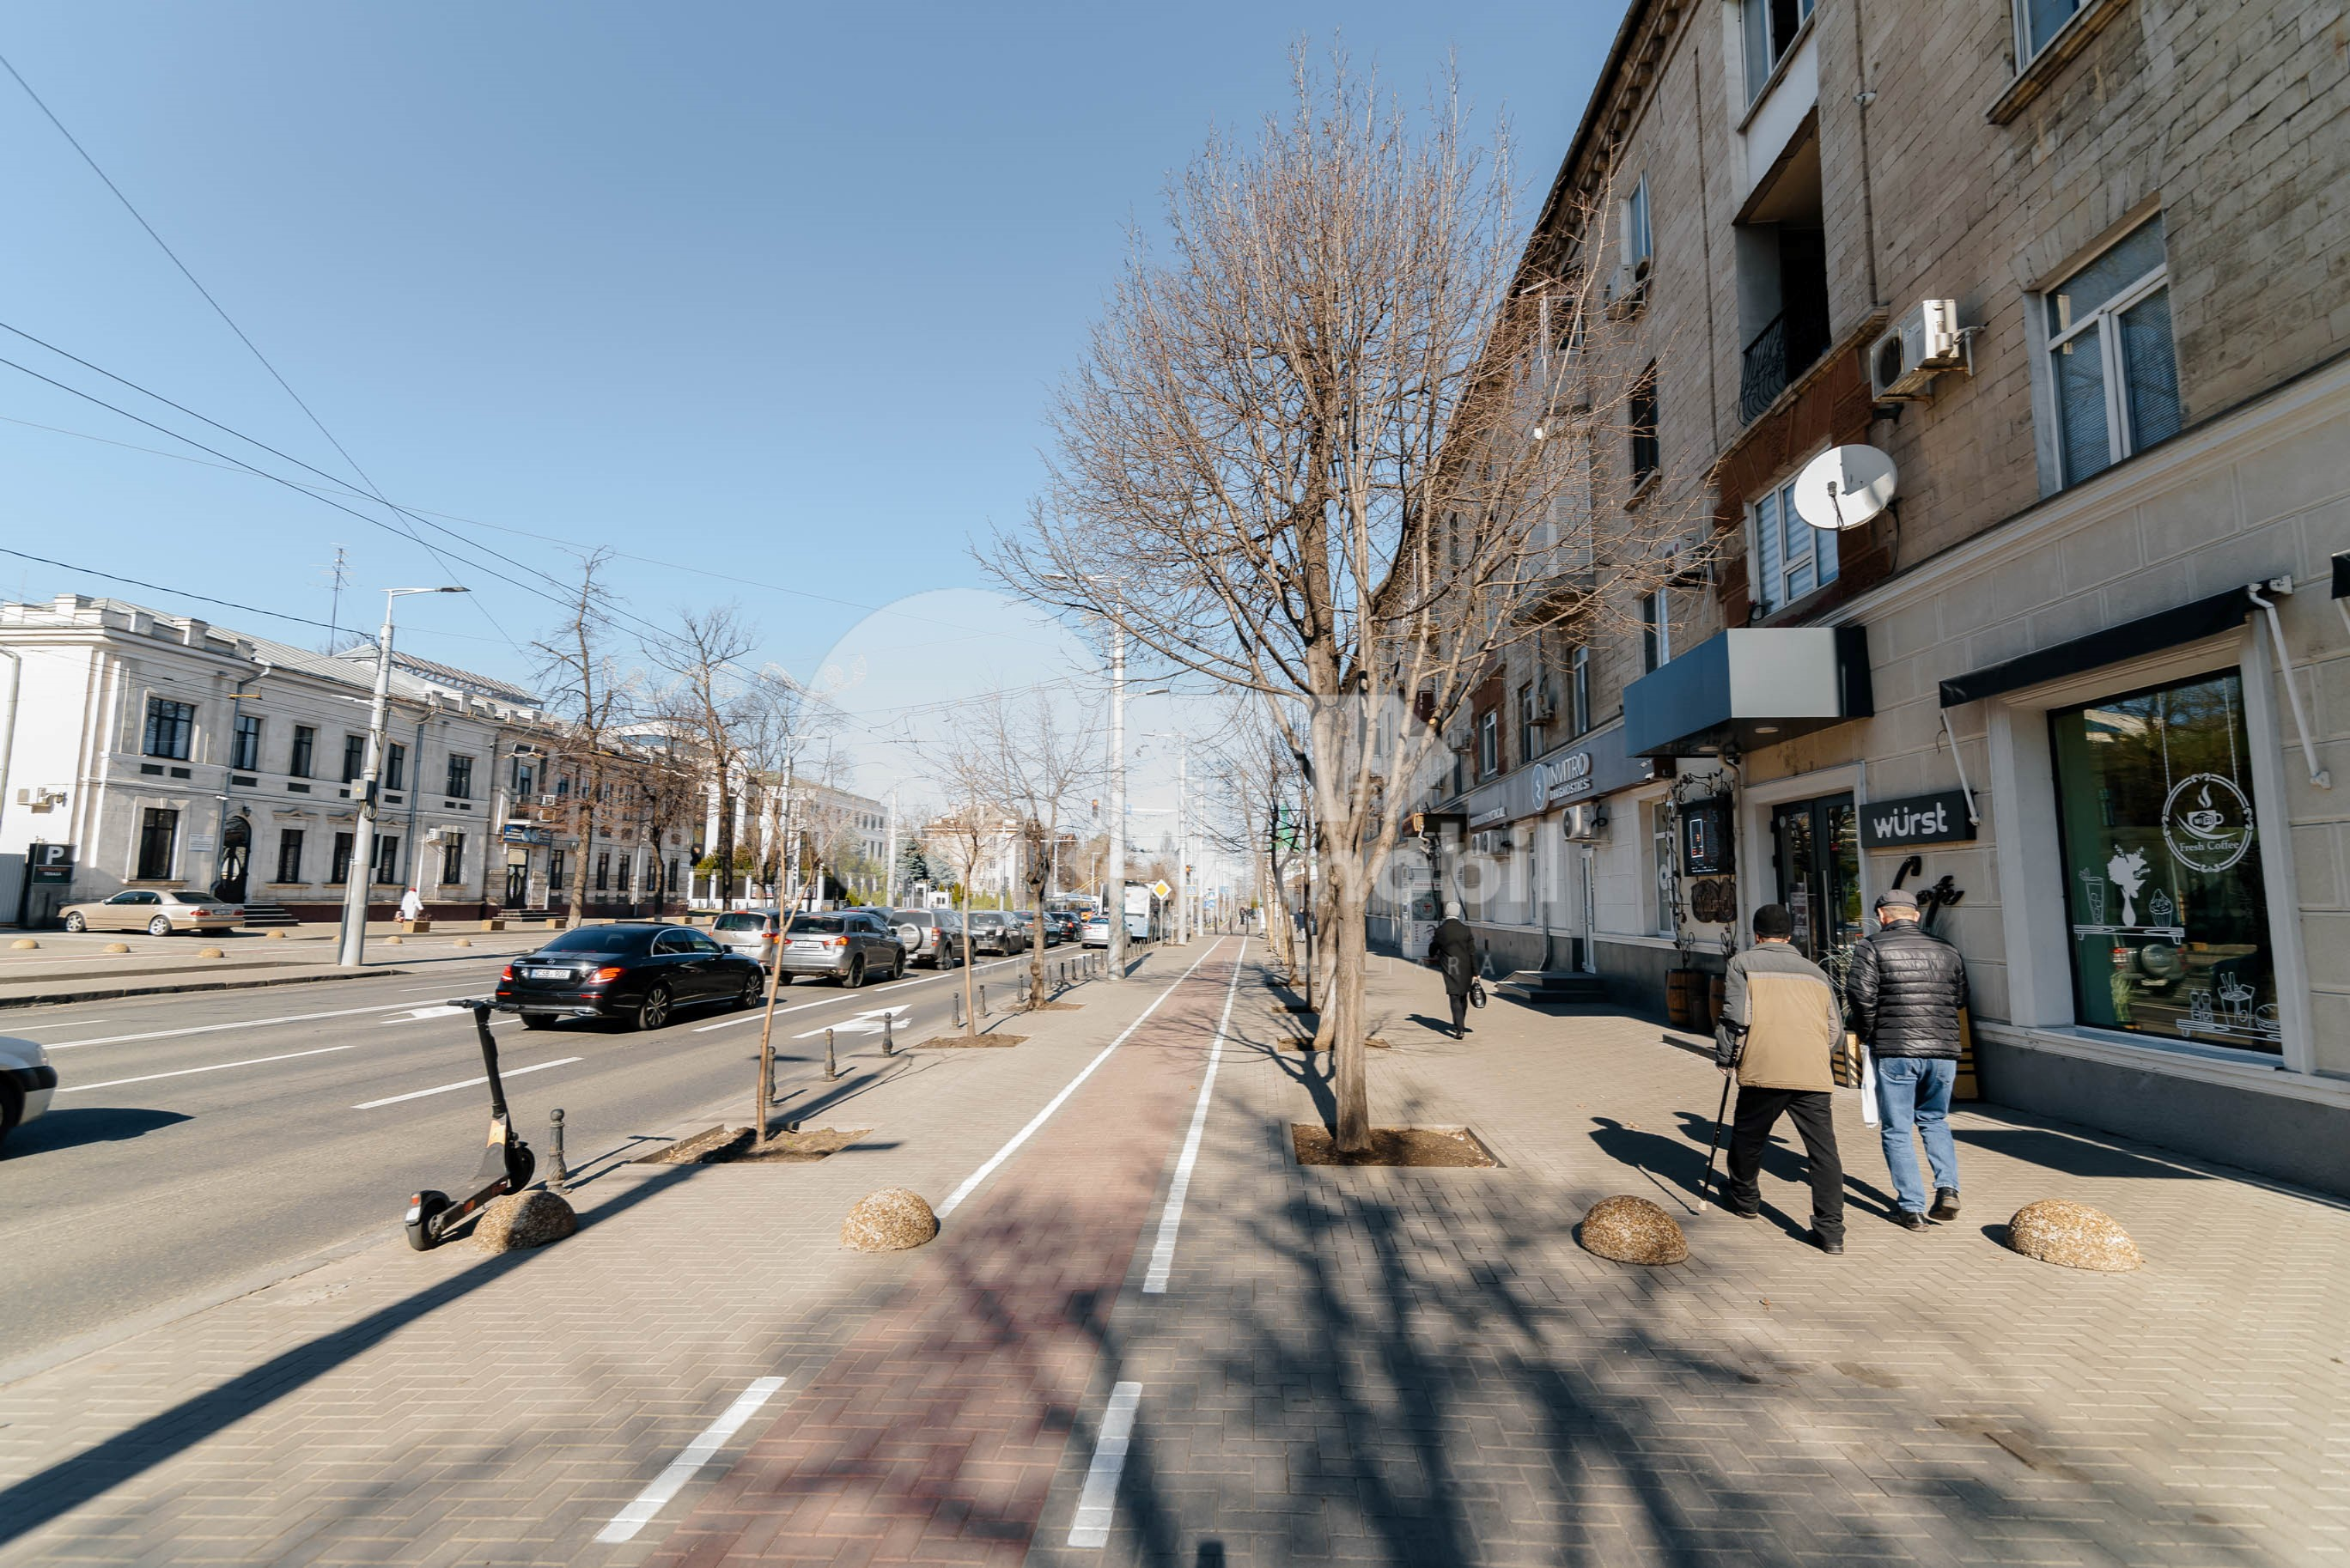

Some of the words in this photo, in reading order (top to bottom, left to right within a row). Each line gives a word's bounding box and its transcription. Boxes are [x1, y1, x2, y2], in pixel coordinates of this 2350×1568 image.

[1548, 752, 1590, 787] INVITRO
[1873, 801, 1948, 839] würst
[46, 846, 64, 865] P
[2179, 842, 2205, 852] Fresh
[2207, 840, 2240, 851] Coffee
